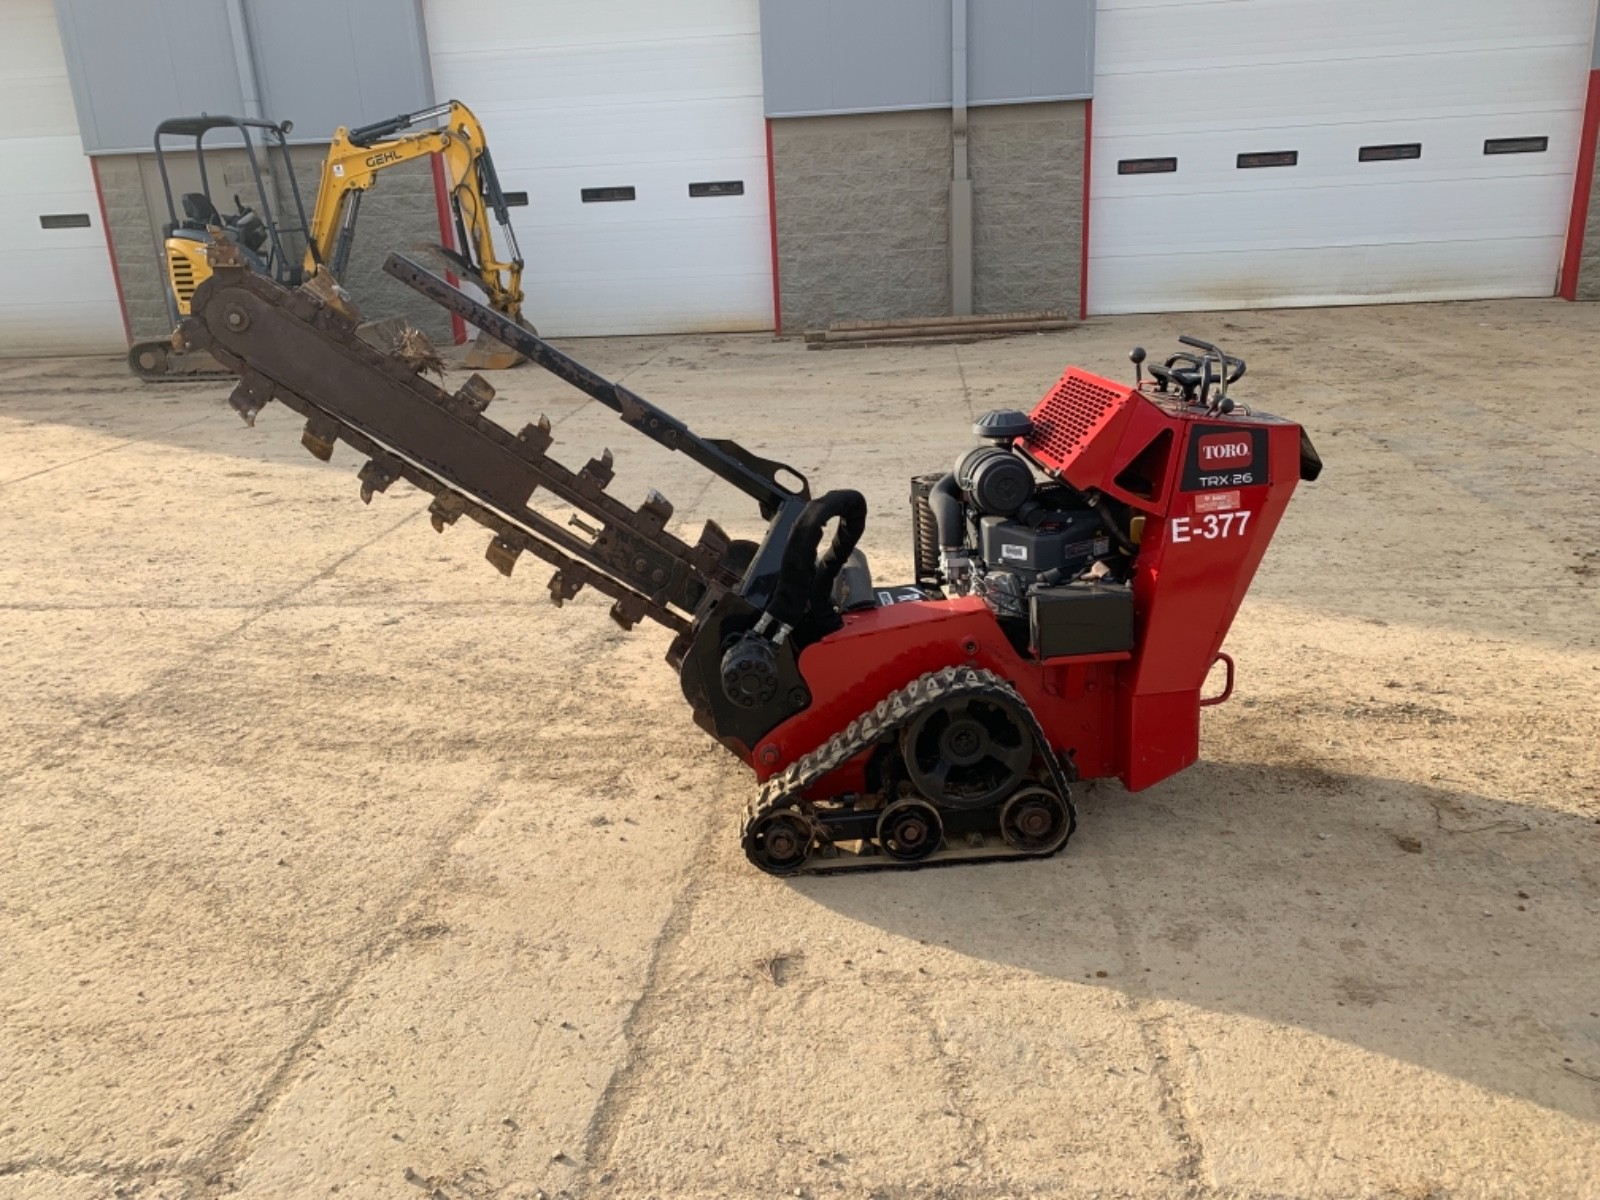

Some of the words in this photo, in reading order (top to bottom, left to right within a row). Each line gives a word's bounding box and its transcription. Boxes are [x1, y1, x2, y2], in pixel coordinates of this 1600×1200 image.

[366, 151, 402, 167] GEHL
[1203, 443, 1249, 459] TORO
[1172, 511, 1251, 543] E-377
